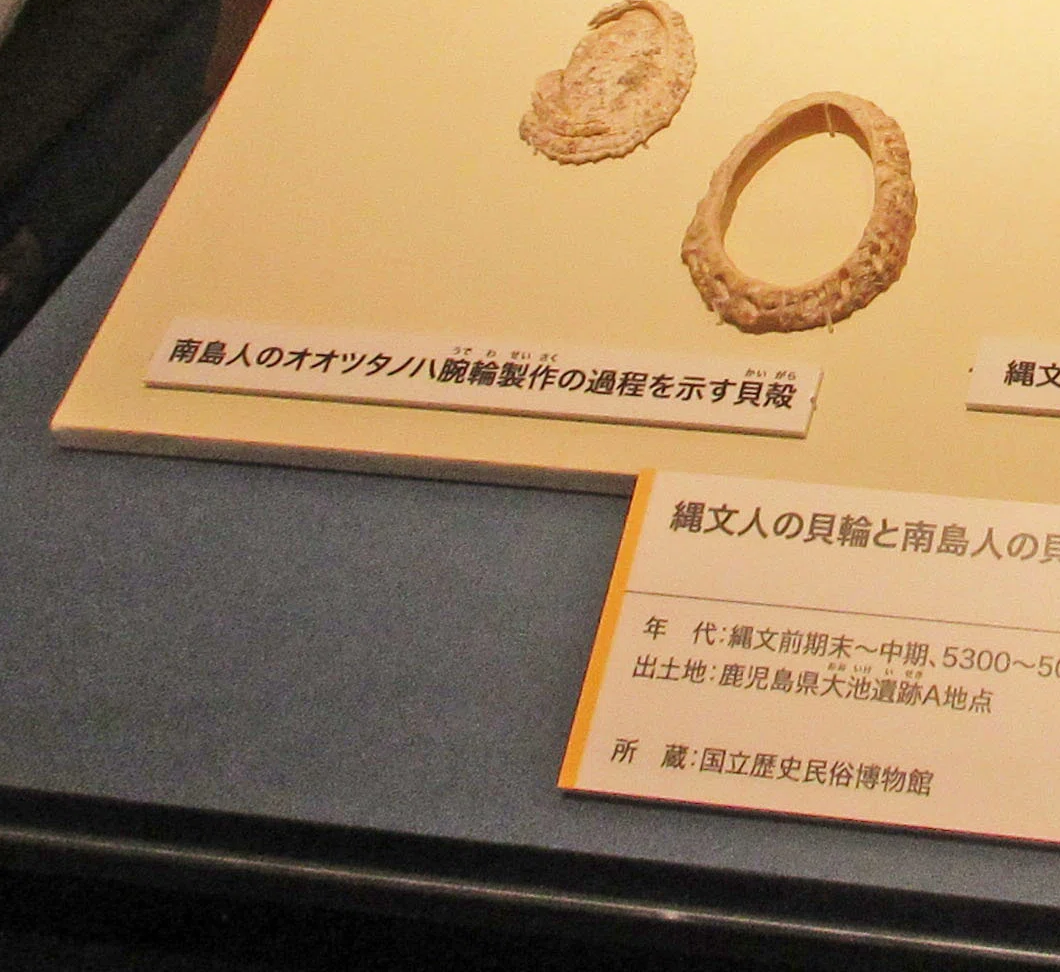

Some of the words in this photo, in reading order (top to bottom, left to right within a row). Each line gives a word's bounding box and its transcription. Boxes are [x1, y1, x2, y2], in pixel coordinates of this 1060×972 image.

[168, 338, 797, 409] 南島人のオオツタノハ腕輪製作の過程を示す貝殻
